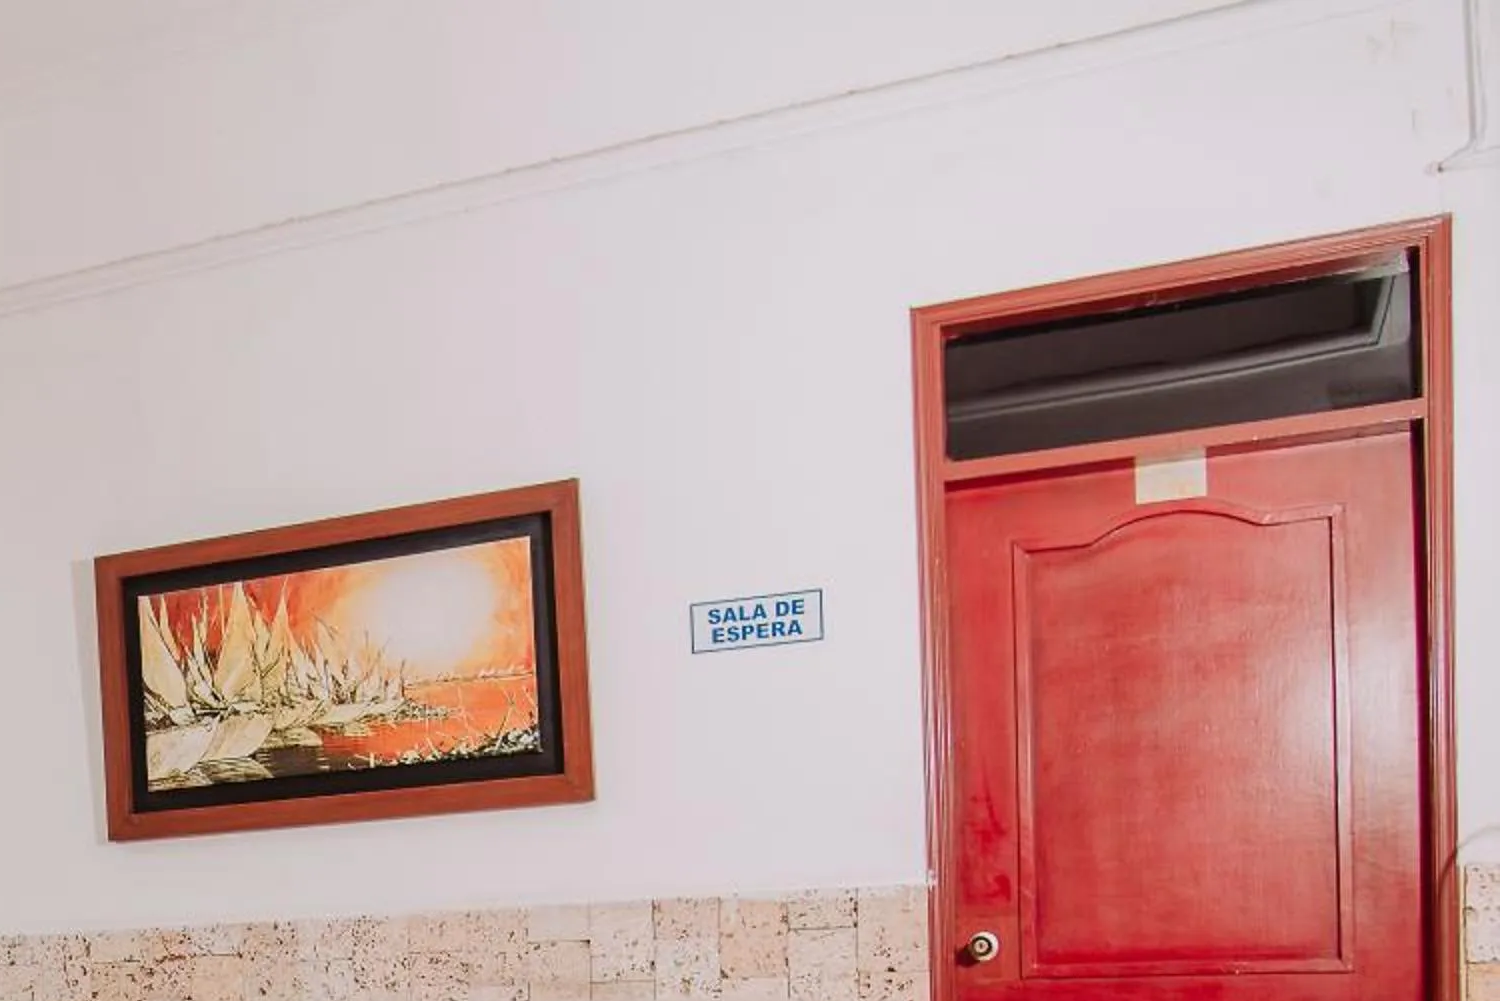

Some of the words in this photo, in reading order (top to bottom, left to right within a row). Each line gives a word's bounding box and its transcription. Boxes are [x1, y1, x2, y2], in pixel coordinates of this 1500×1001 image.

[708, 603, 767, 625] SALA
[776, 598, 805, 617] DE
[712, 619, 804, 644] ESPERA
